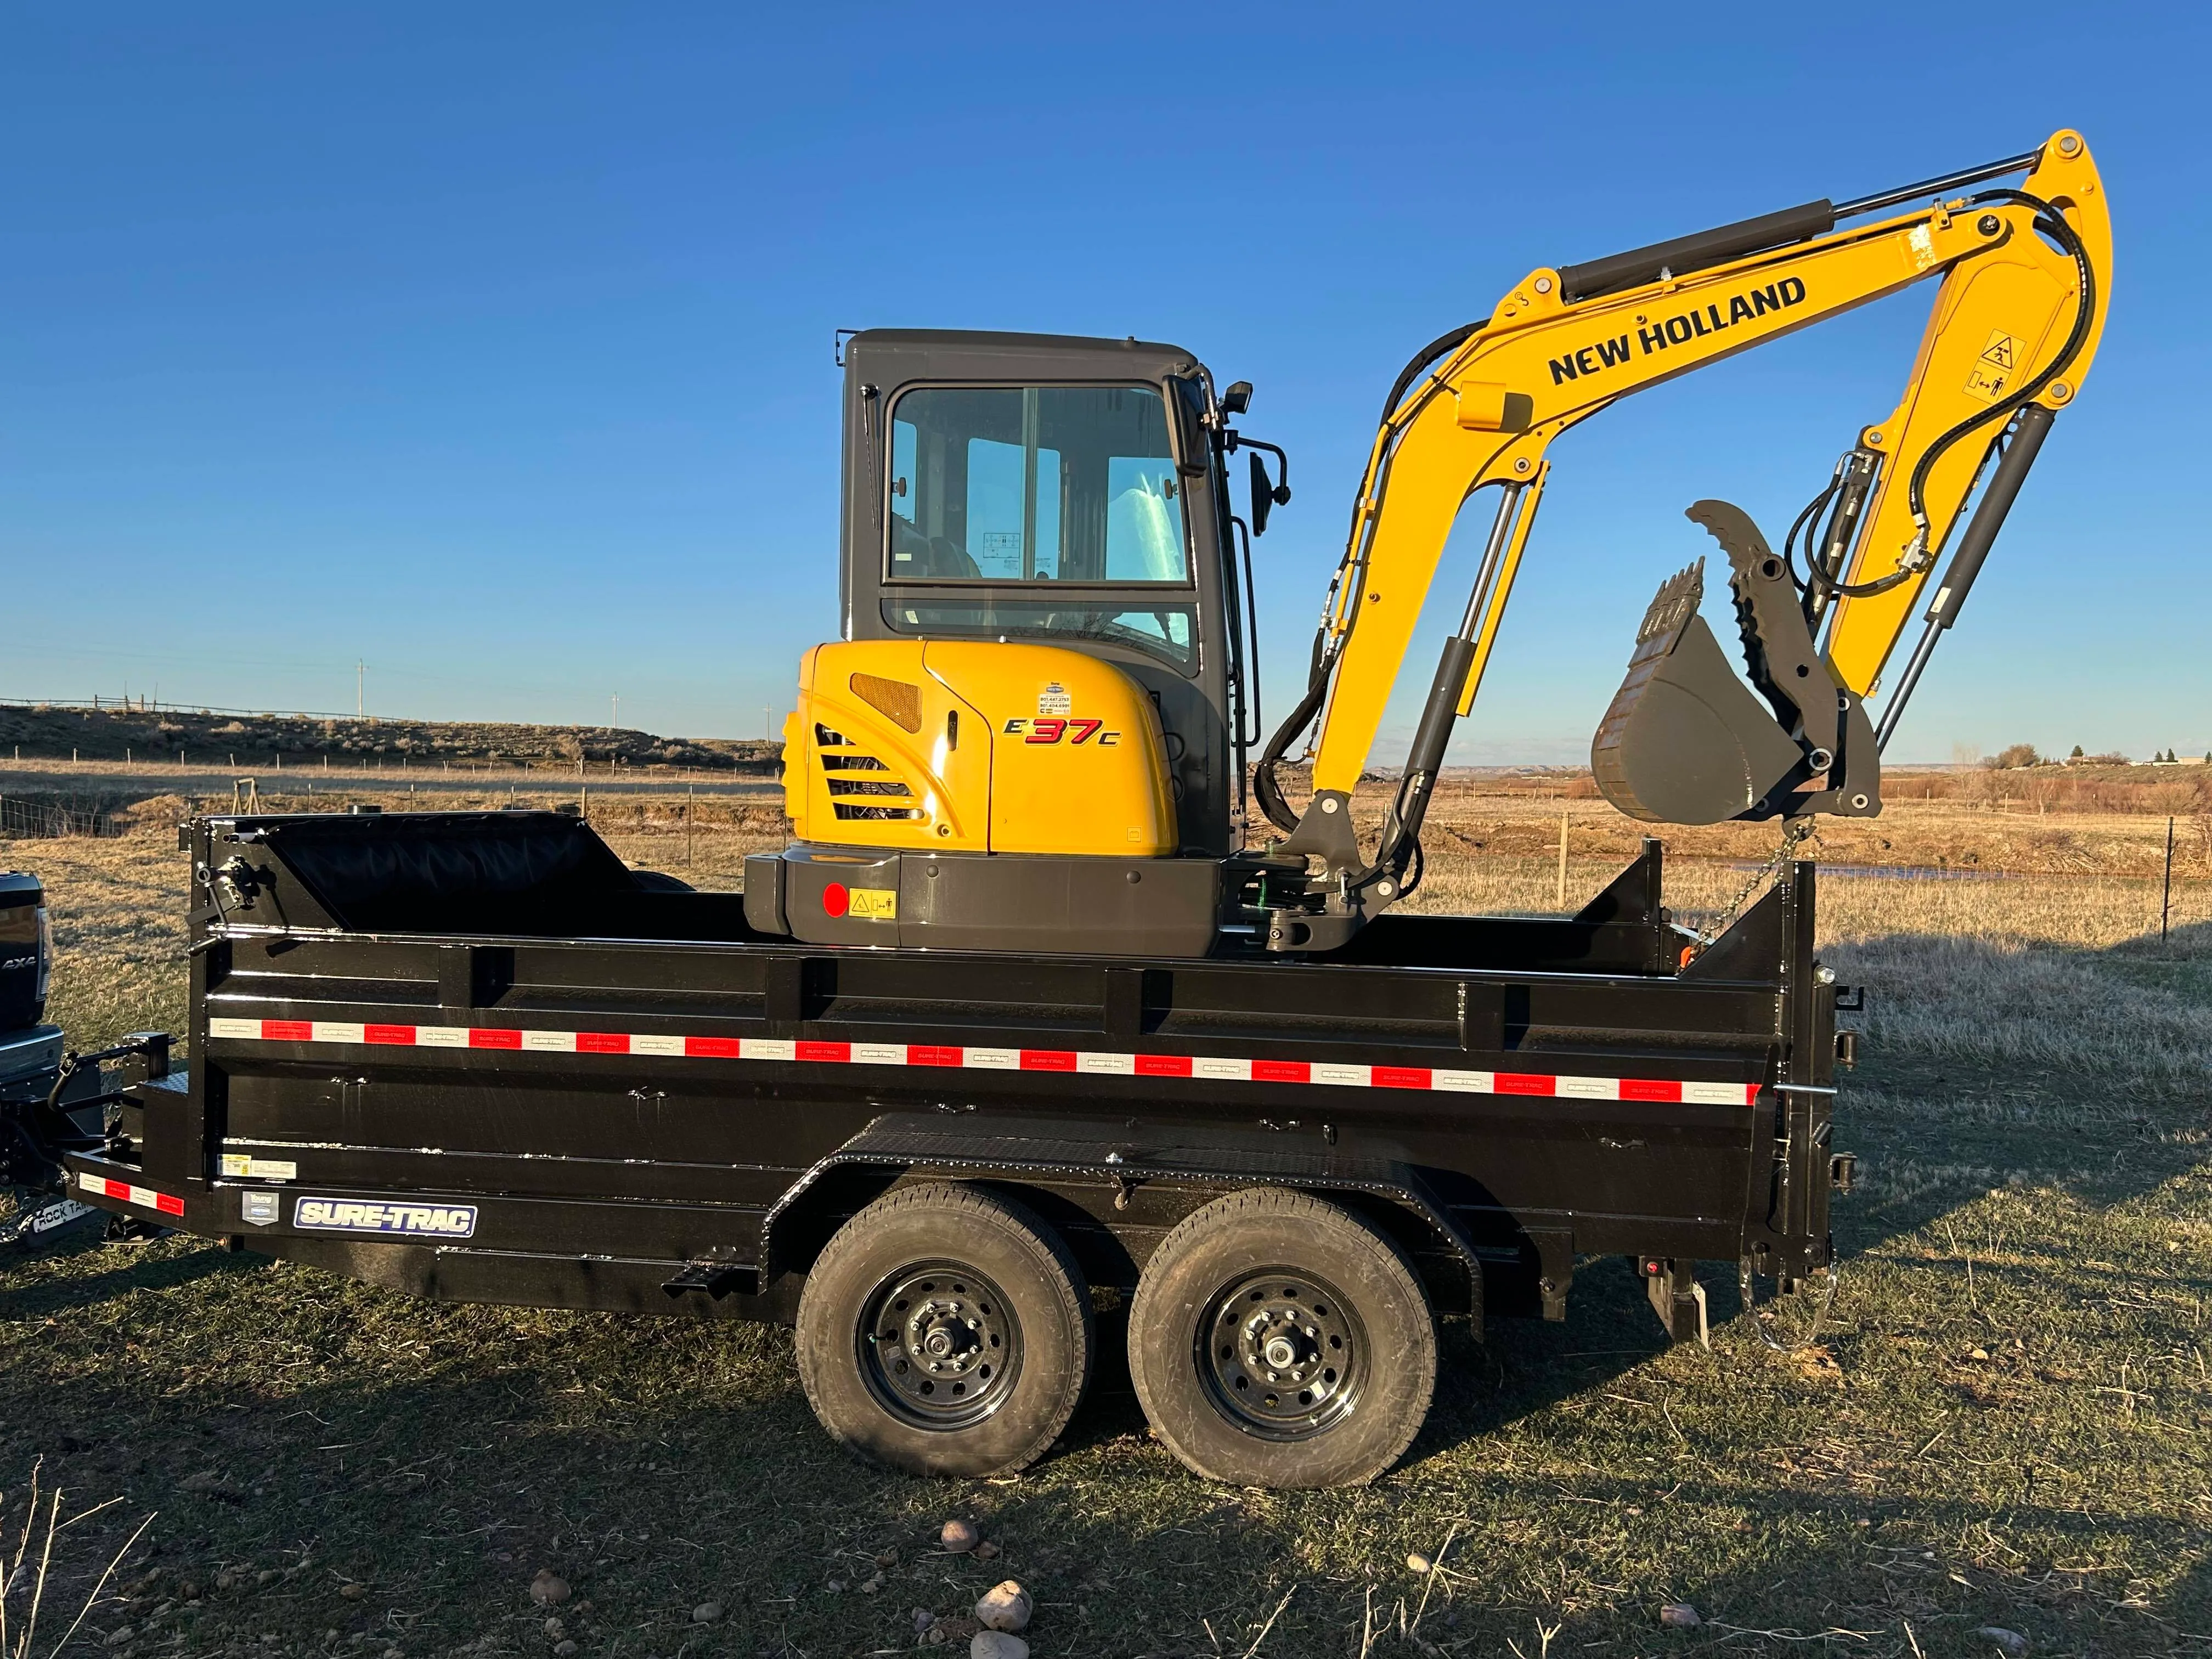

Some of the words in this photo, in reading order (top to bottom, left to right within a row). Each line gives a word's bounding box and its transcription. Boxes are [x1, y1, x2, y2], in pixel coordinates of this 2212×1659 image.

[1548, 334, 1630, 386] NEW
[1637, 276, 1807, 355] HOLLAND
[2, 956, 36, 970] 4X4
[300, 1201, 471, 1233] SURE-TRAC
